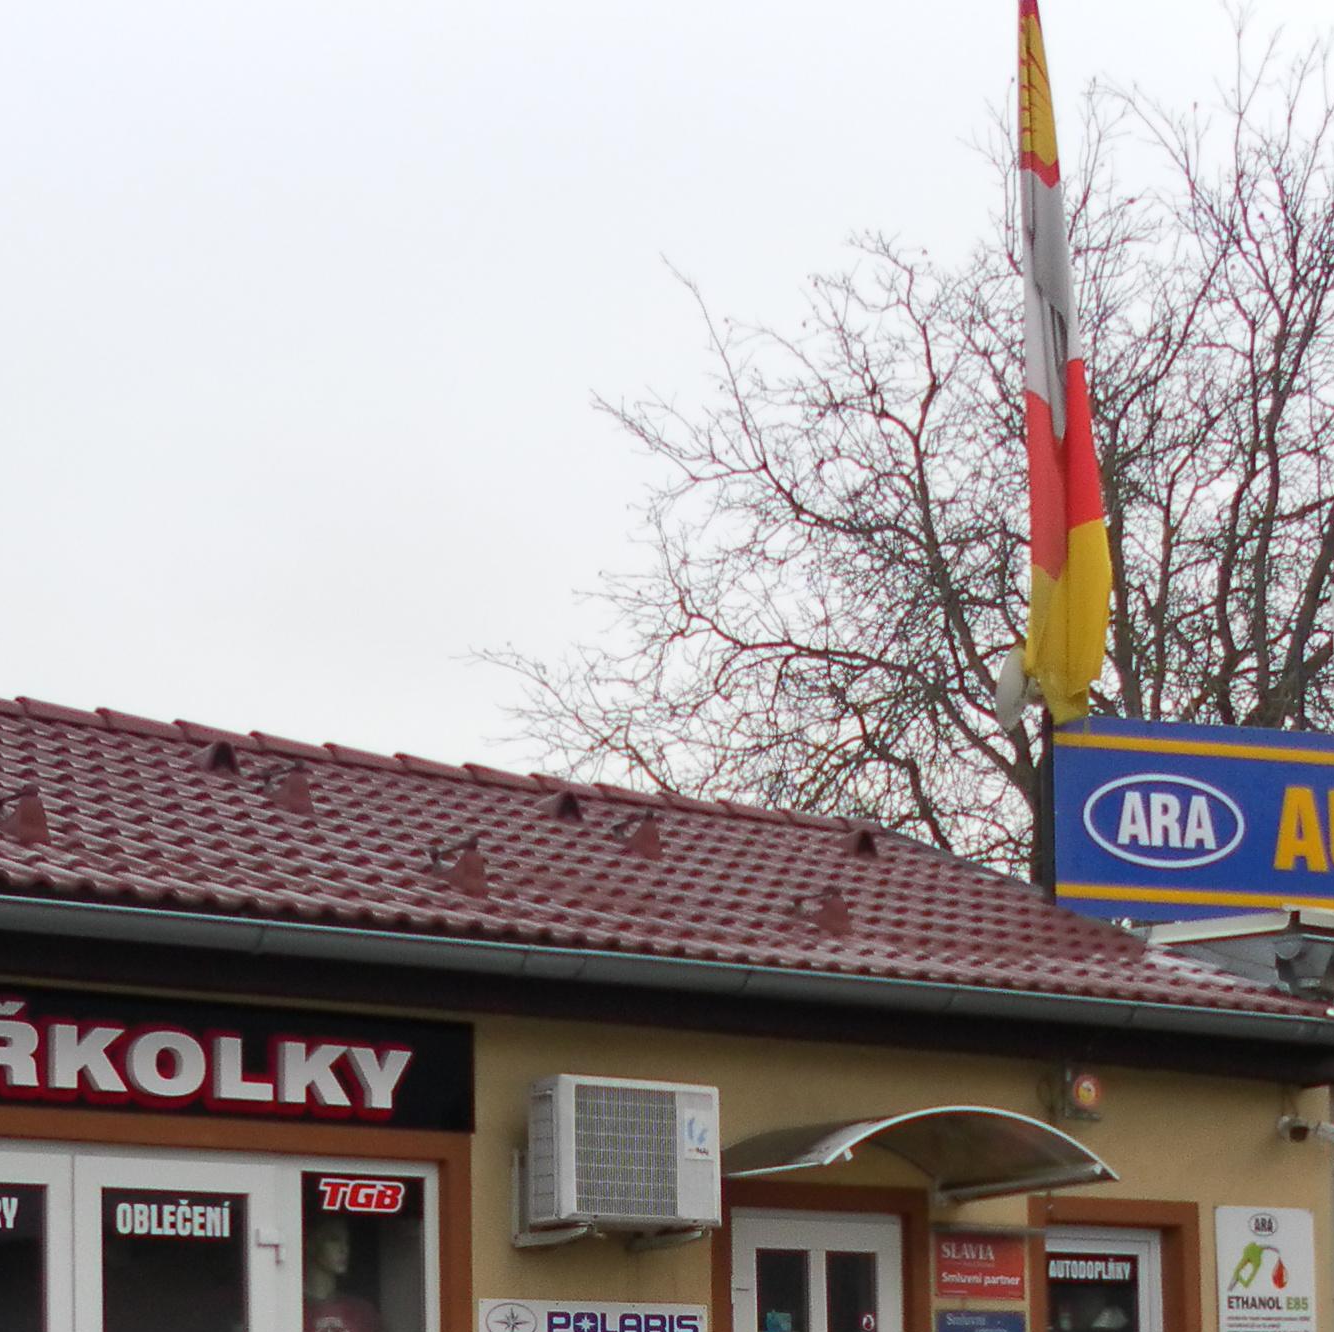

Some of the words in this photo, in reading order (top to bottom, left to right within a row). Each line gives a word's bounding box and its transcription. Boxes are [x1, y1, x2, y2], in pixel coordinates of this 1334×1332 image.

[1116, 790, 1219, 852] ARA
[318, 1177, 406, 1213] TGB
[115, 1198, 232, 1238] OBLEČENÍ
[1048, 1257, 1131, 1281] AUTODOPLŇKY
[1227, 1296, 1282, 1310] ETHANOL
[1286, 1297, 1309, 1311] E85
